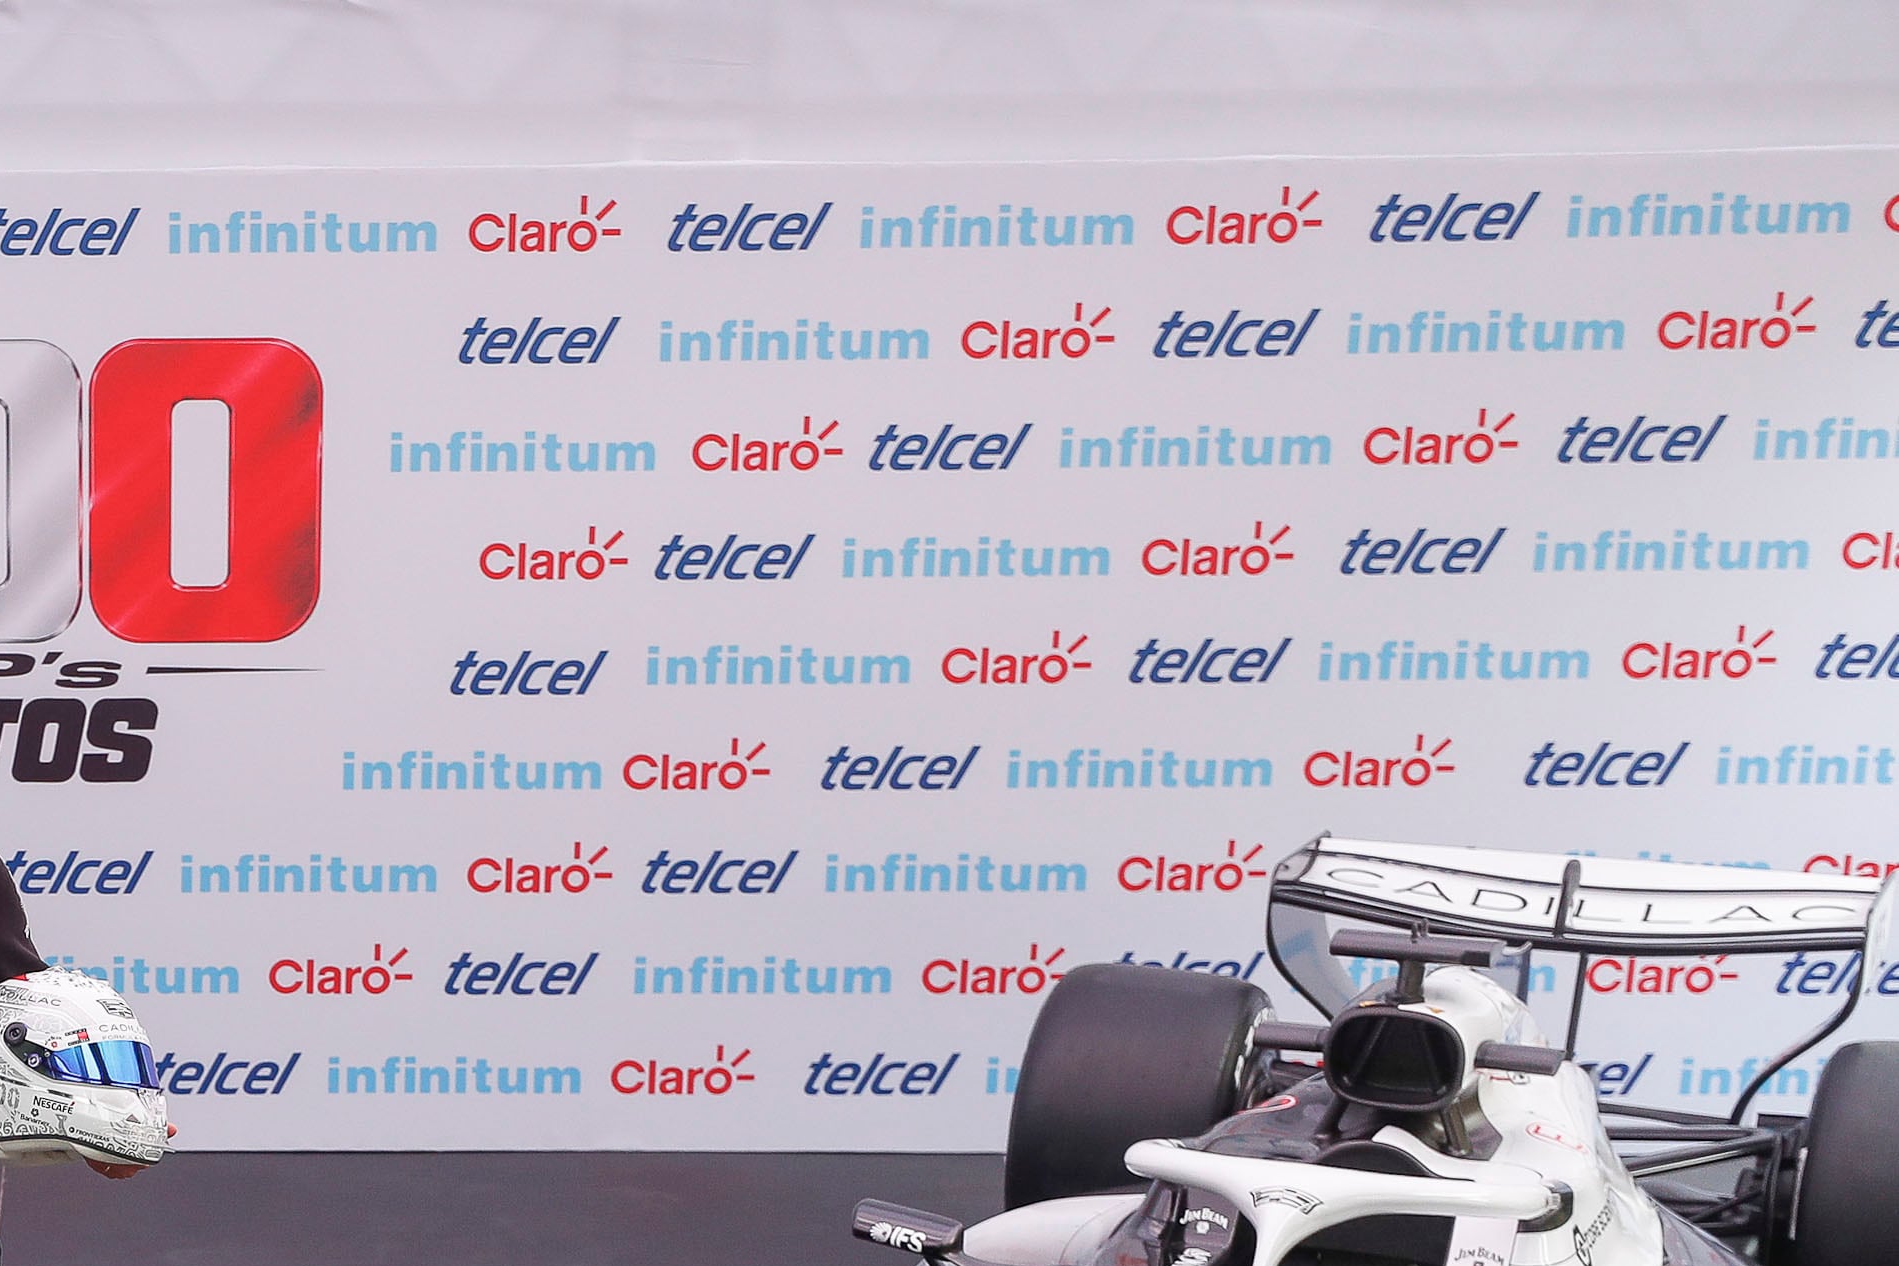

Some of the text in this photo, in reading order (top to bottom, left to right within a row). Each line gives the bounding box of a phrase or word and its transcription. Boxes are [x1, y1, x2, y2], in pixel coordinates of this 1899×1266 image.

[168, 210, 438, 255] infinitum
[468, 210, 602, 253] Claro
[860, 203, 1135, 249] infinitum
[1165, 201, 1302, 246] Claro
[1369, 190, 1540, 243] telcel
[1567, 191, 1851, 238] infinitum
[458, 307, 1796, 365] telcel infinitum telcel infinitum Claro
[390, 414, 1726, 473] infinitum Claro infinitum Claro telcel
[478, 527, 1810, 581] Claro telcel infinitum telcel infinitum
[450, 639, 1756, 696] telcel infinitum Claro infinitum Claro
[342, 741, 1689, 791] infinitum Claro telcel Claro telcel
[180, 853, 438, 894] infinitum
[466, 855, 595, 894] Claro
[641, 849, 798, 895] telcel
[824, 852, 1088, 894] infinitum
[1117, 853, 1247, 893] Claro
[1326, 866, 1858, 925] CADILLAC
[268, 957, 395, 996] Claro
[444, 951, 599, 996] telcel
[633, 955, 893, 995] infinitum
[921, 957, 1048, 995] Claro
[1583, 953, 1718, 994] Claro
[151, 1051, 302, 1096] telcel
[327, 1055, 583, 1095] infinitum
[610, 1058, 737, 1096] Claro
[804, 1052, 960, 1096] telcel
